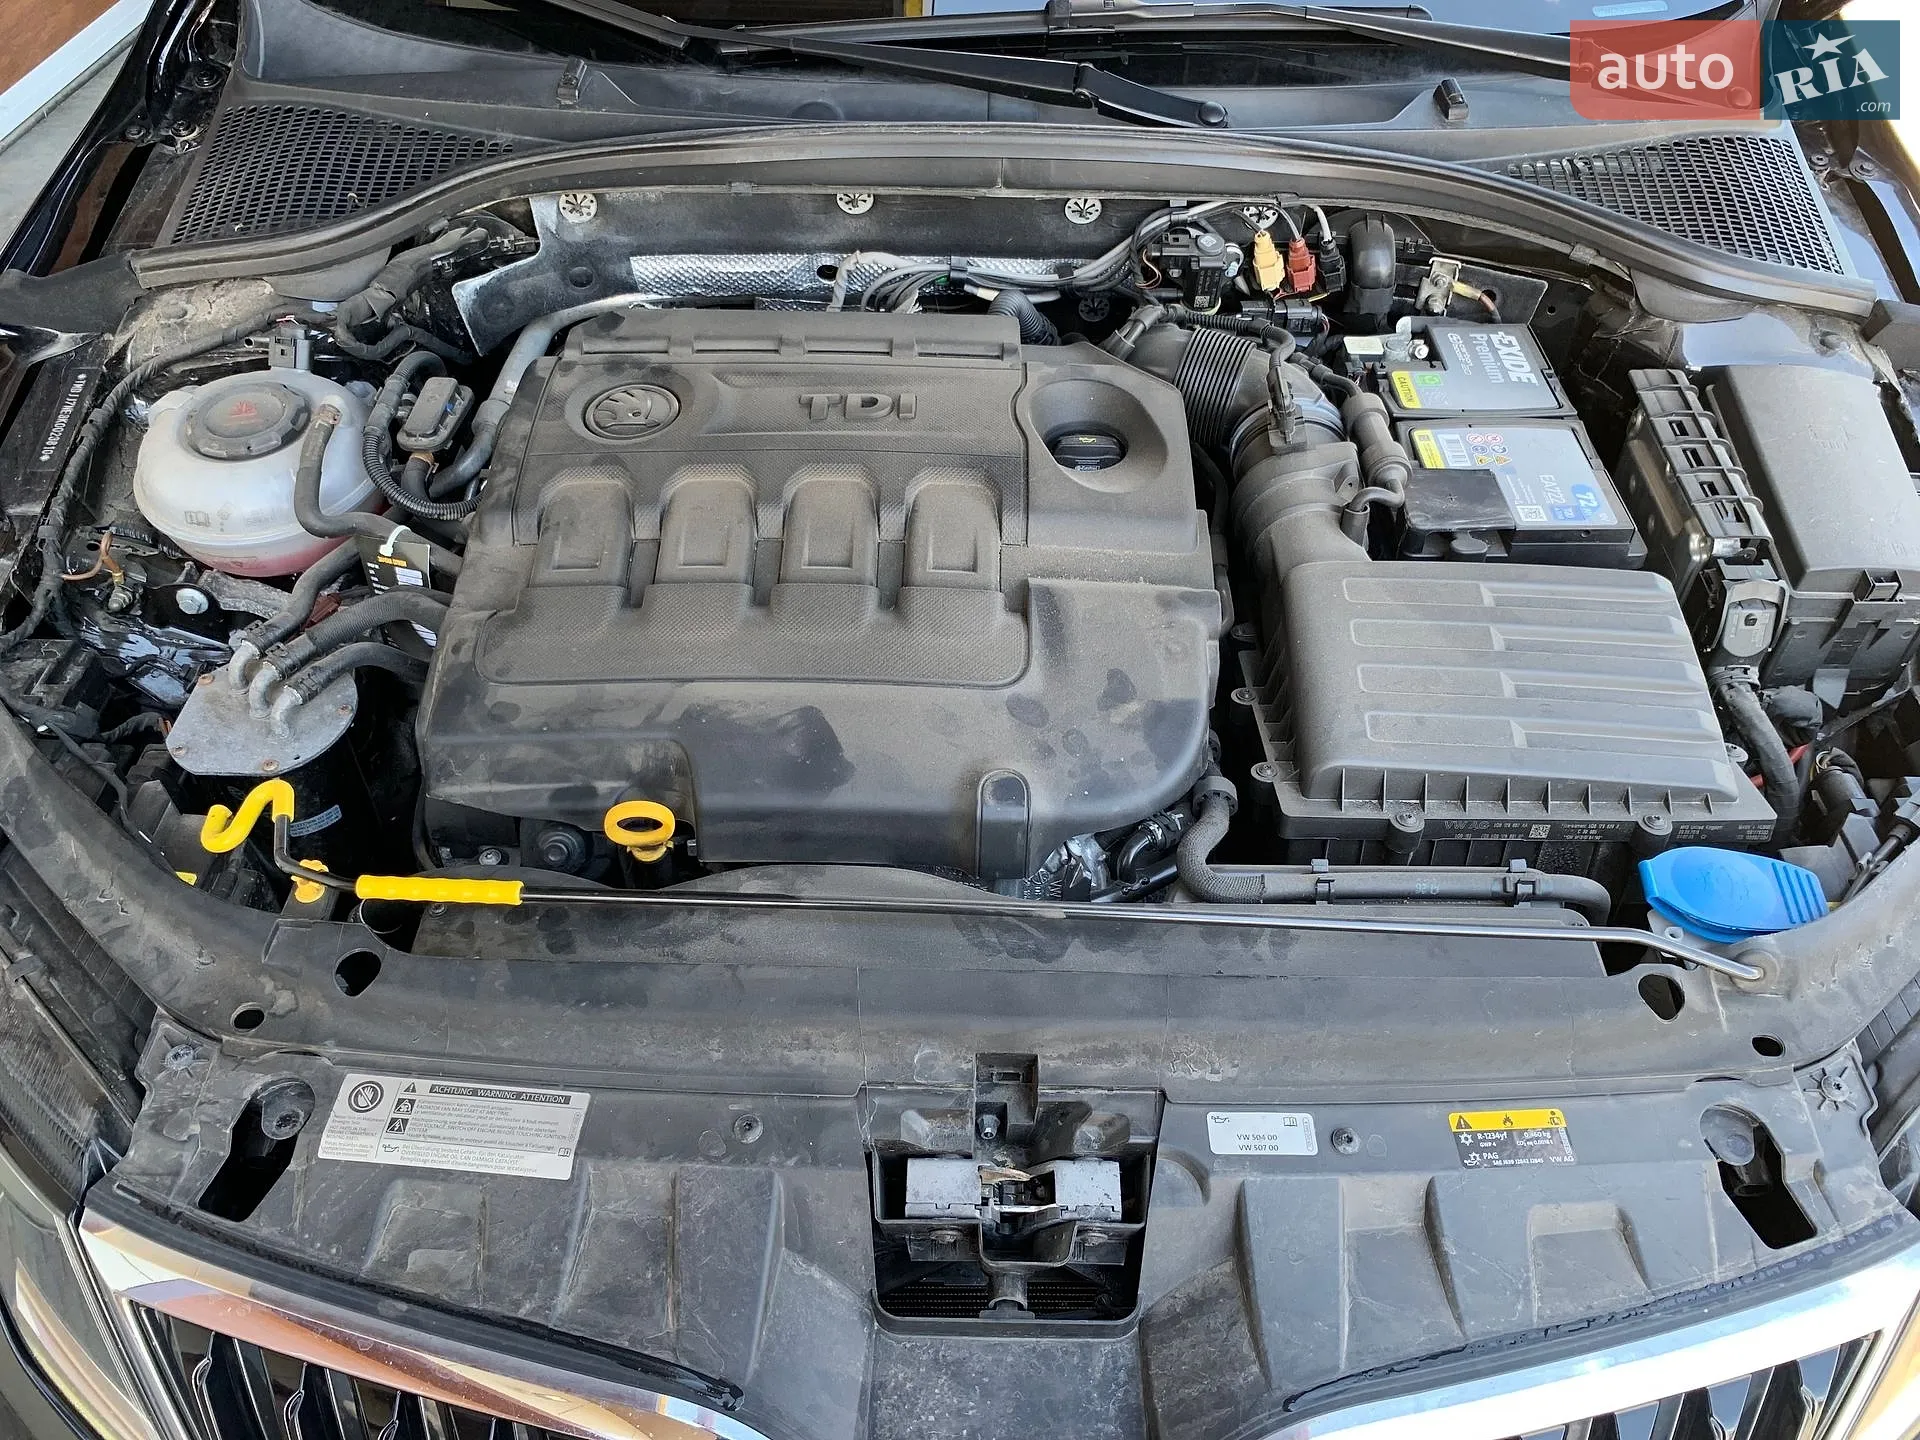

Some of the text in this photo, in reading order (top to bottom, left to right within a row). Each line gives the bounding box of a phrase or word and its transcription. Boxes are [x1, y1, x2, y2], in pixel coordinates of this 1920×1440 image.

[1469, 333, 1505, 384] Premium
[1490, 331, 1538, 386] EXIDE
[1398, 375, 1415, 404] CAUTION
[799, 393, 917, 420] TDI
[1575, 492, 1598, 507] 72
[433, 1085, 566, 1104] ACHTUNG WARNING ATTENTION
[1476, 1131, 1508, 1141] R-1234yf
[1268, 1144, 1279, 1152] 00
[1482, 1152, 1499, 1160] PAG
